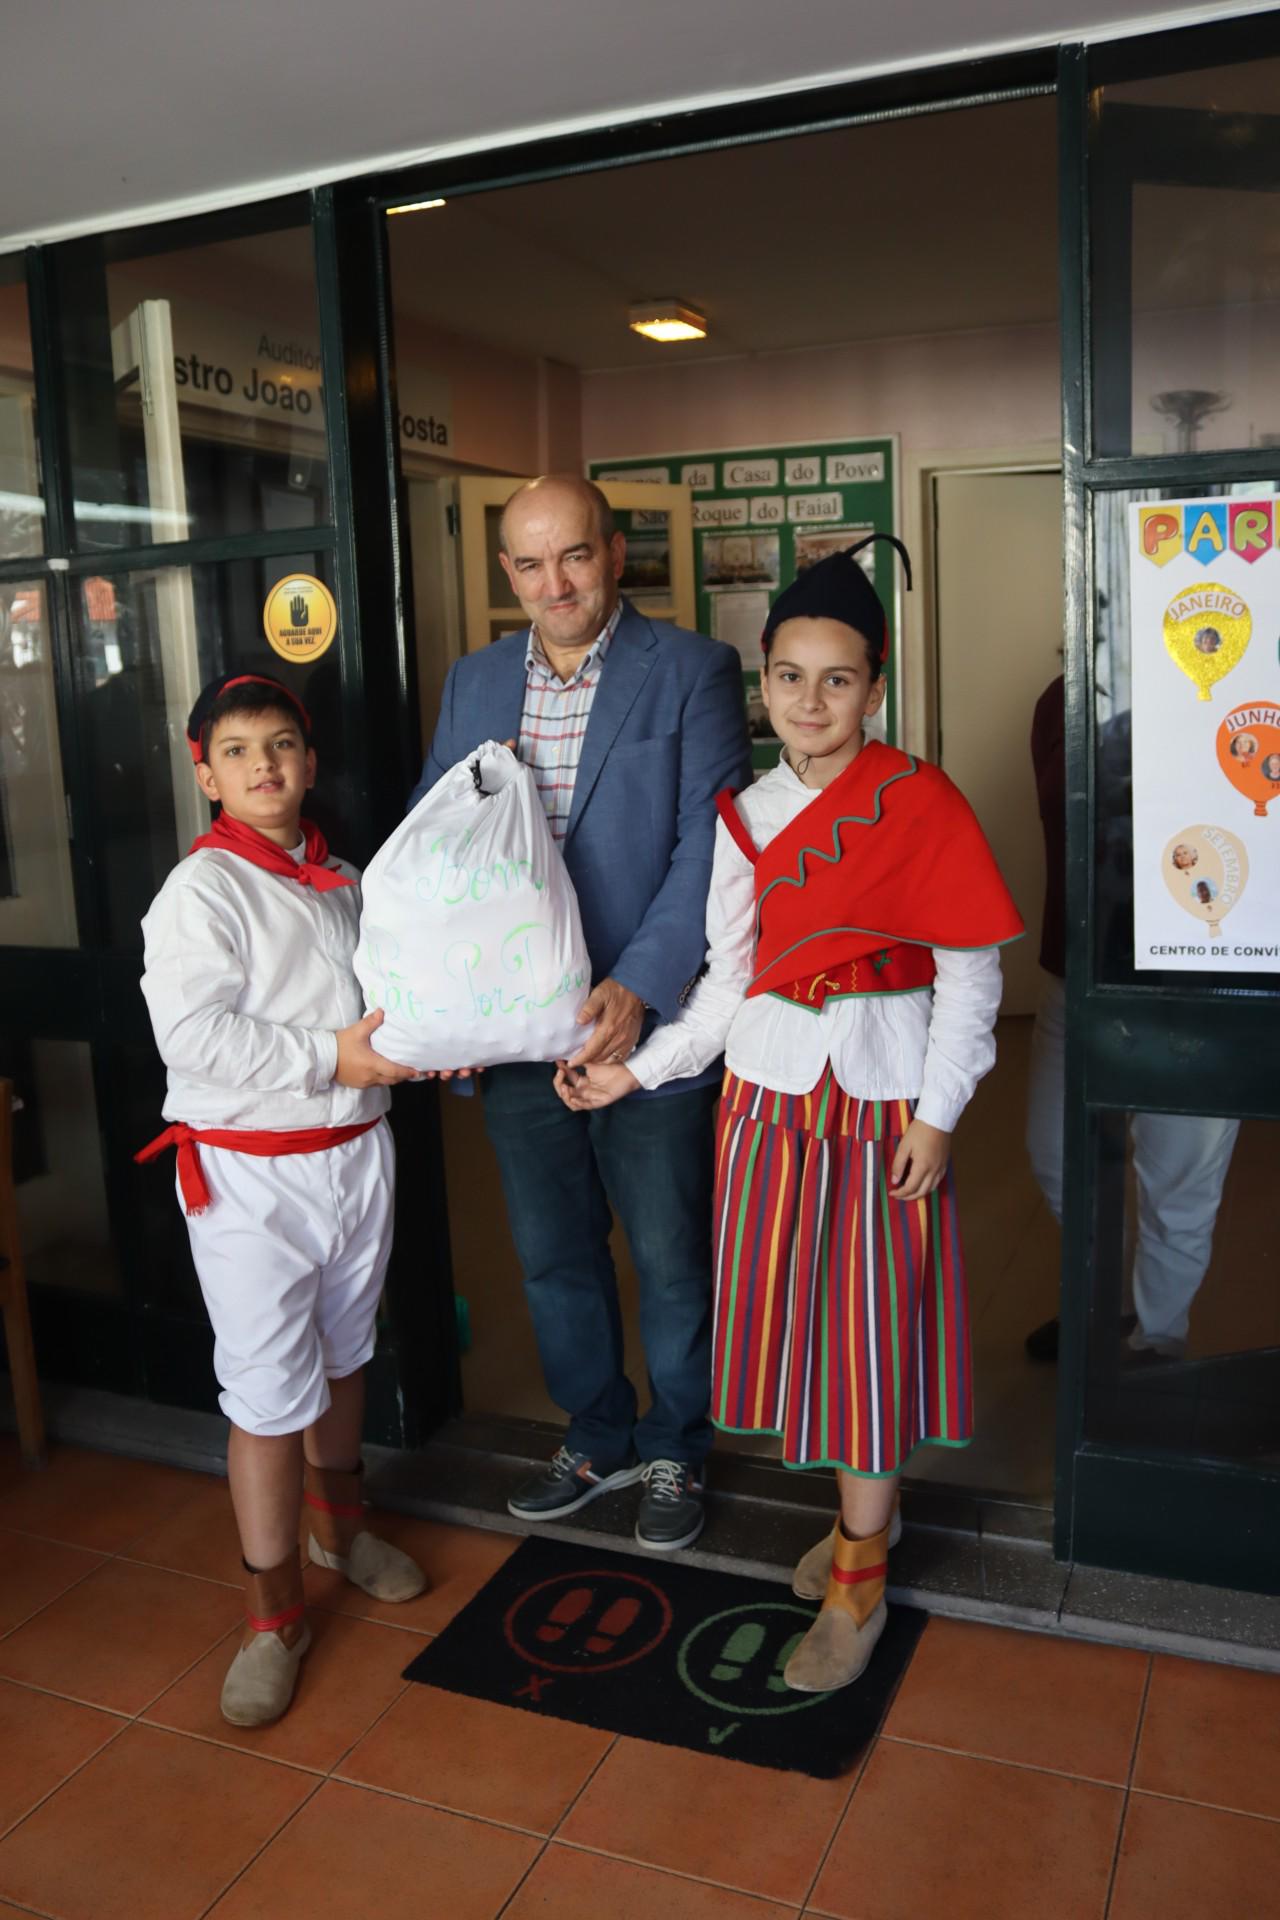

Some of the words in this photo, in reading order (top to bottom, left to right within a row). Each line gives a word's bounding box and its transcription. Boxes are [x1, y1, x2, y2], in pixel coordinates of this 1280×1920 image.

[244, 368, 312, 415] Joao
[400, 413, 449, 446] osta
[687, 470, 708, 488] da
[730, 465, 772, 484] Casa
[792, 462, 814, 481] do
[757, 502, 779, 520] do
[796, 499, 838, 518] Faial
[1144, 510, 1280, 556] PAR
[1170, 593, 1246, 620] JANEIRO
[1204, 827, 1238, 905] SETEMBRO
[1150, 946, 1206, 956] CENTRO
[1211, 946, 1230, 956] DE
[1233, 945, 1280, 957] CONVÍ
